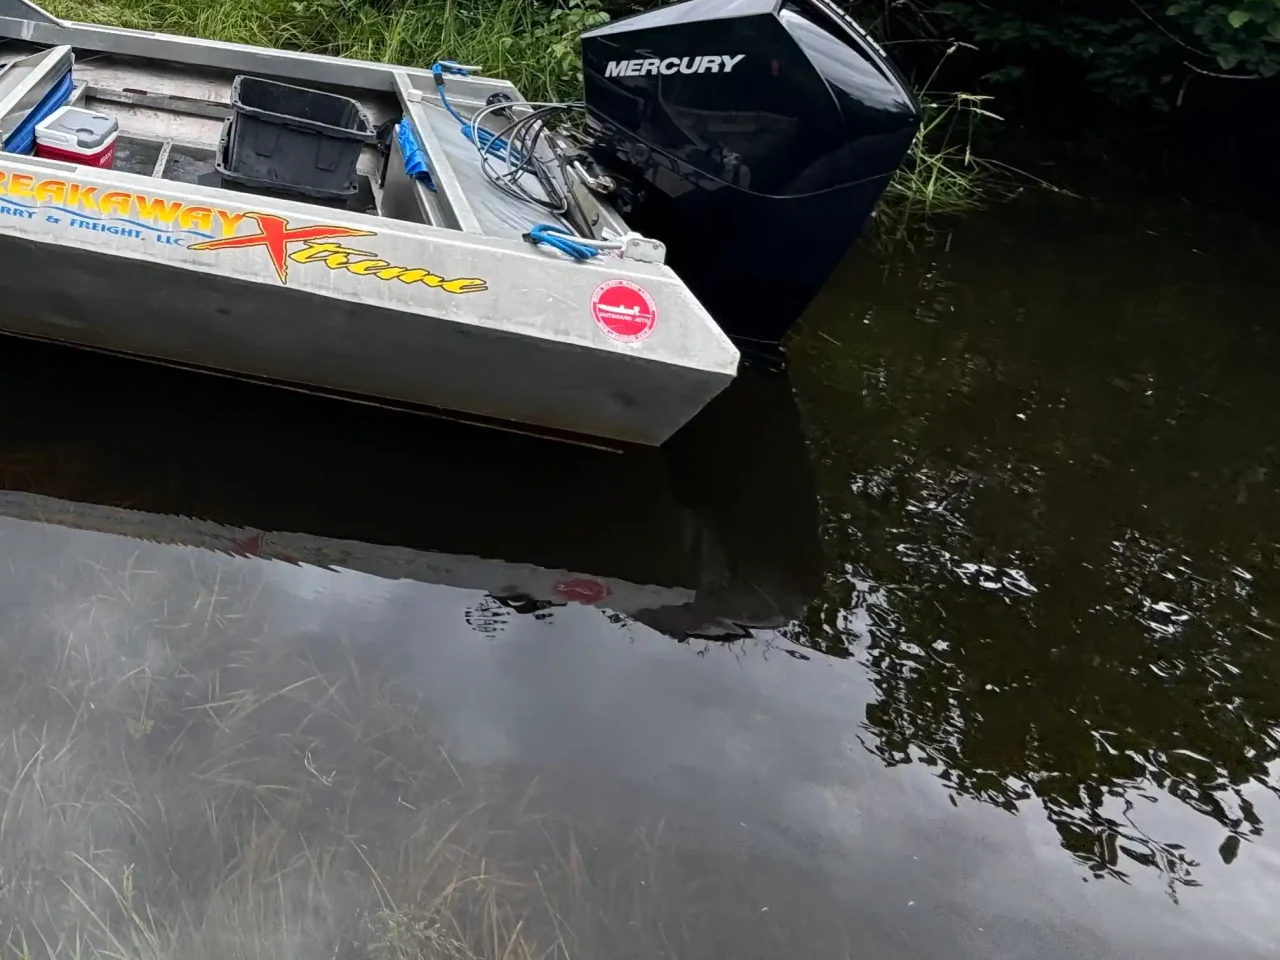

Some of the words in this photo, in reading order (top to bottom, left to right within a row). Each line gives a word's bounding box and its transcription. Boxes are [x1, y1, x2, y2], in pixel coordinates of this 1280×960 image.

[604, 54, 747, 78] MERCURY
[45, 214, 62, 225] &
[156, 234, 186, 247] LLC
